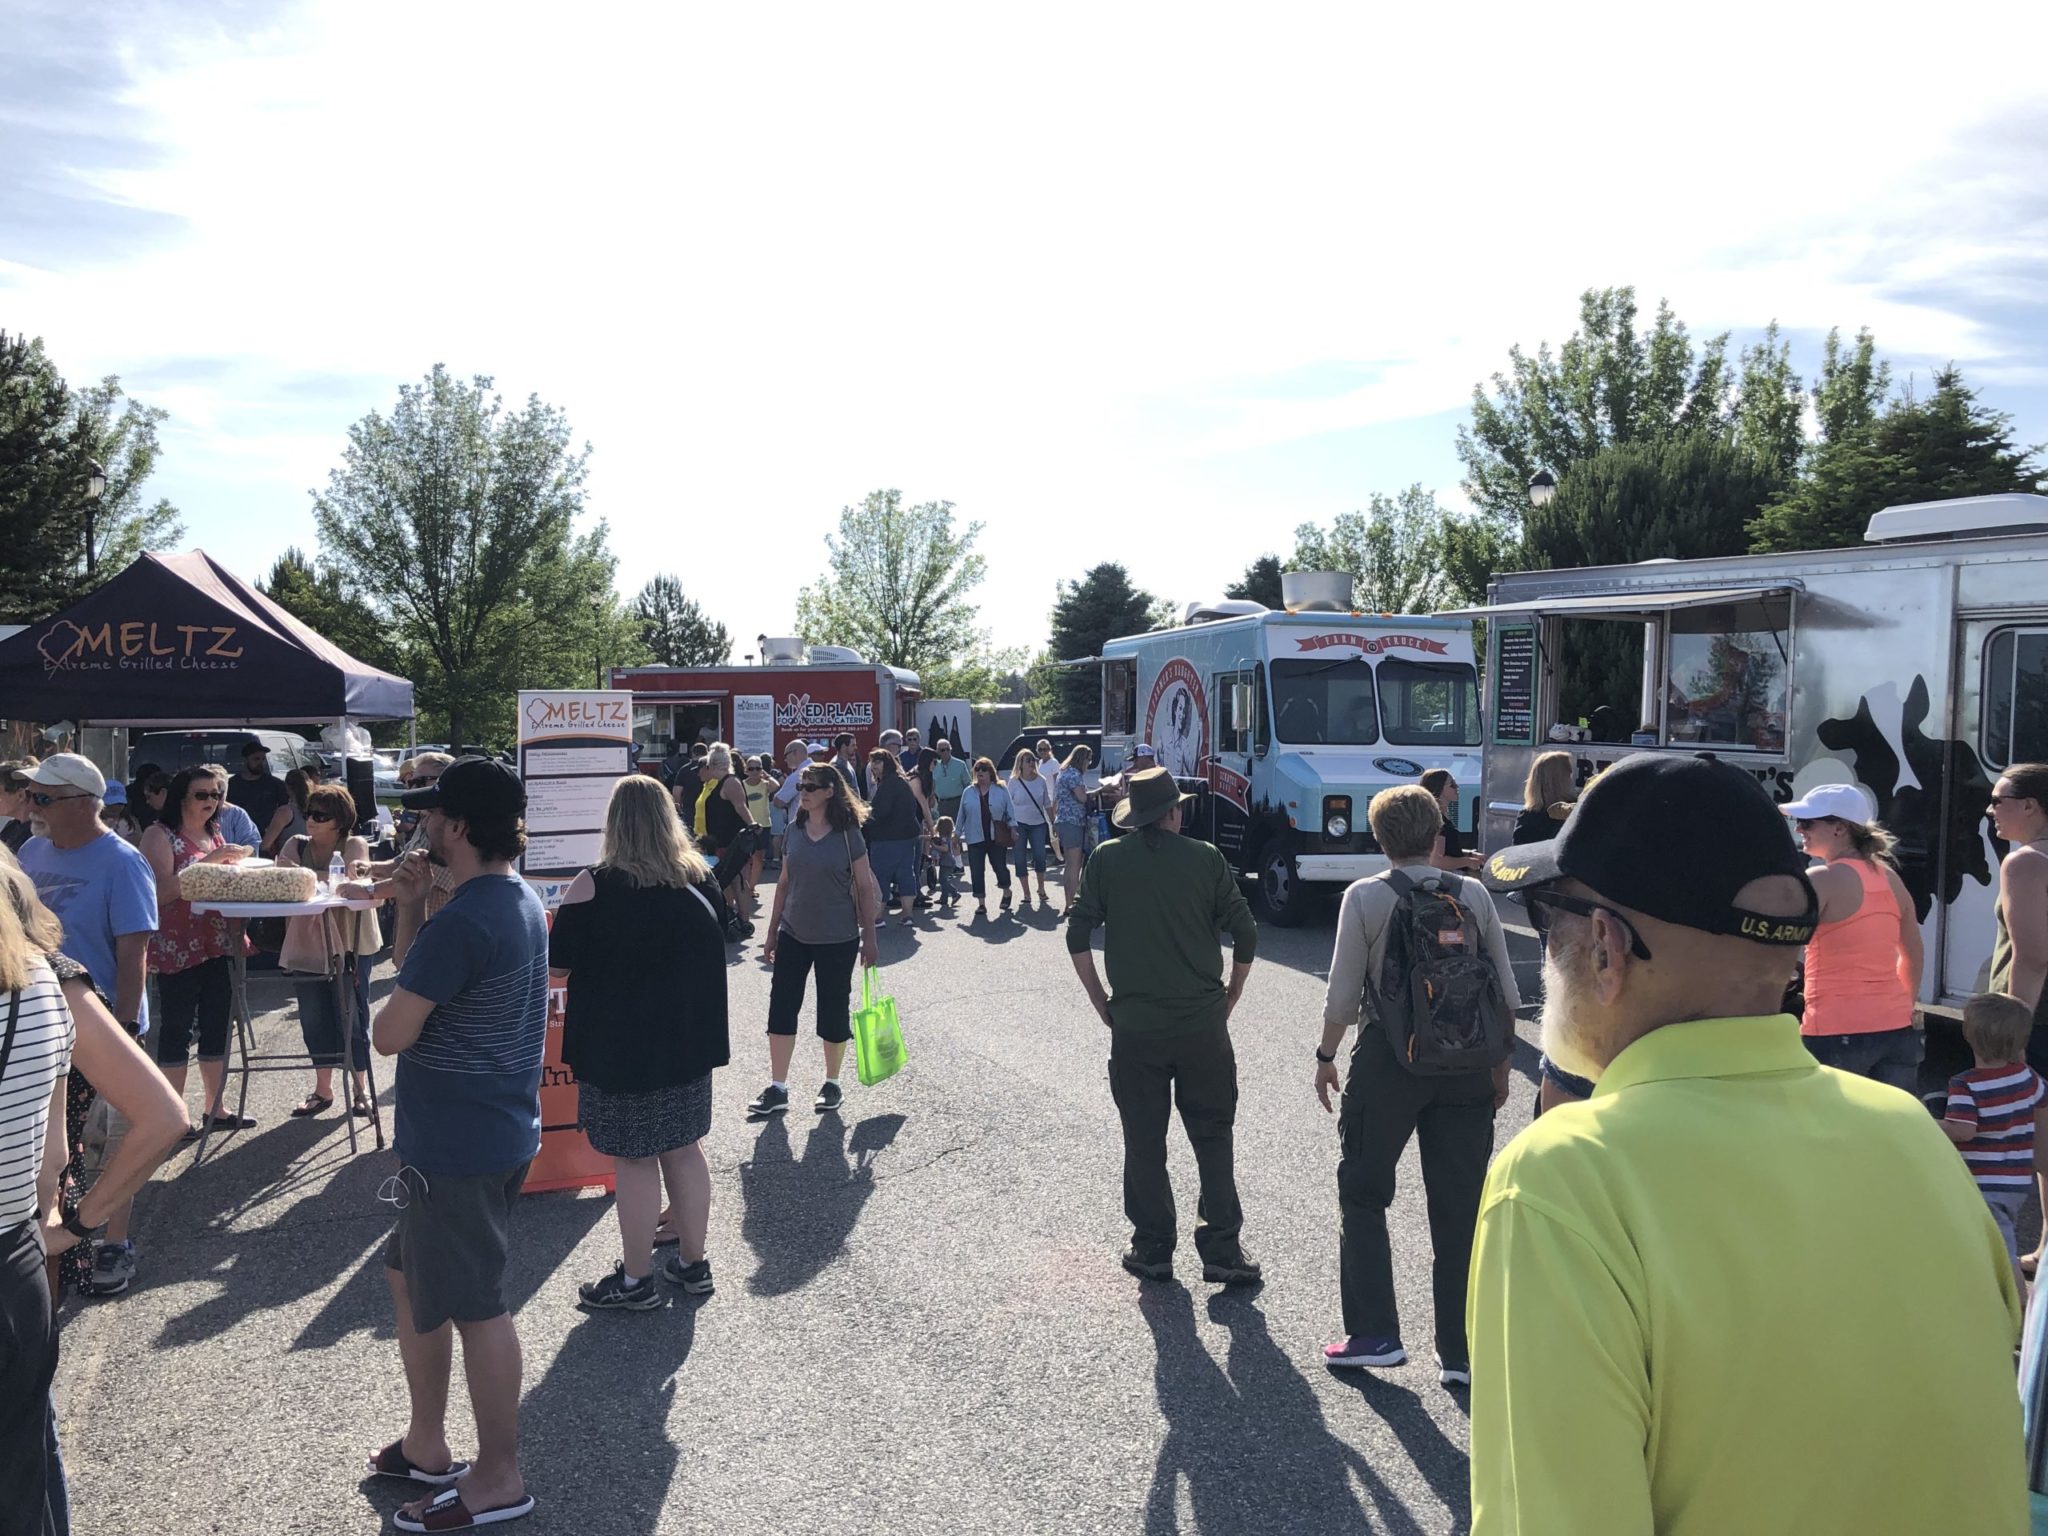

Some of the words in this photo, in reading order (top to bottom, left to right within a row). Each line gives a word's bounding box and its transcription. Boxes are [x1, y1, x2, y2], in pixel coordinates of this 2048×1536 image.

[77, 622, 244, 658] MELTZ
[1324, 636, 1357, 646] FARM
[1385, 637, 1422, 649] TRUCK
[44, 656, 111, 671] Extreme
[119, 656, 173, 671] Grilled
[180, 656, 239, 670] Cheese
[547, 701, 628, 721] MELTZ
[776, 702, 823, 718] MIXED
[826, 703, 872, 717] PLATE
[531, 720, 565, 729] Extreme
[568, 720, 595, 728] Grilled
[597, 720, 626, 728] Cheese
[777, 717, 799, 725] FOOD
[801, 717, 826, 725] TRUCK
[834, 717, 873, 725] CATERING
[1493, 866, 1530, 881] ARMY
[1741, 916, 1769, 938] U.S.
